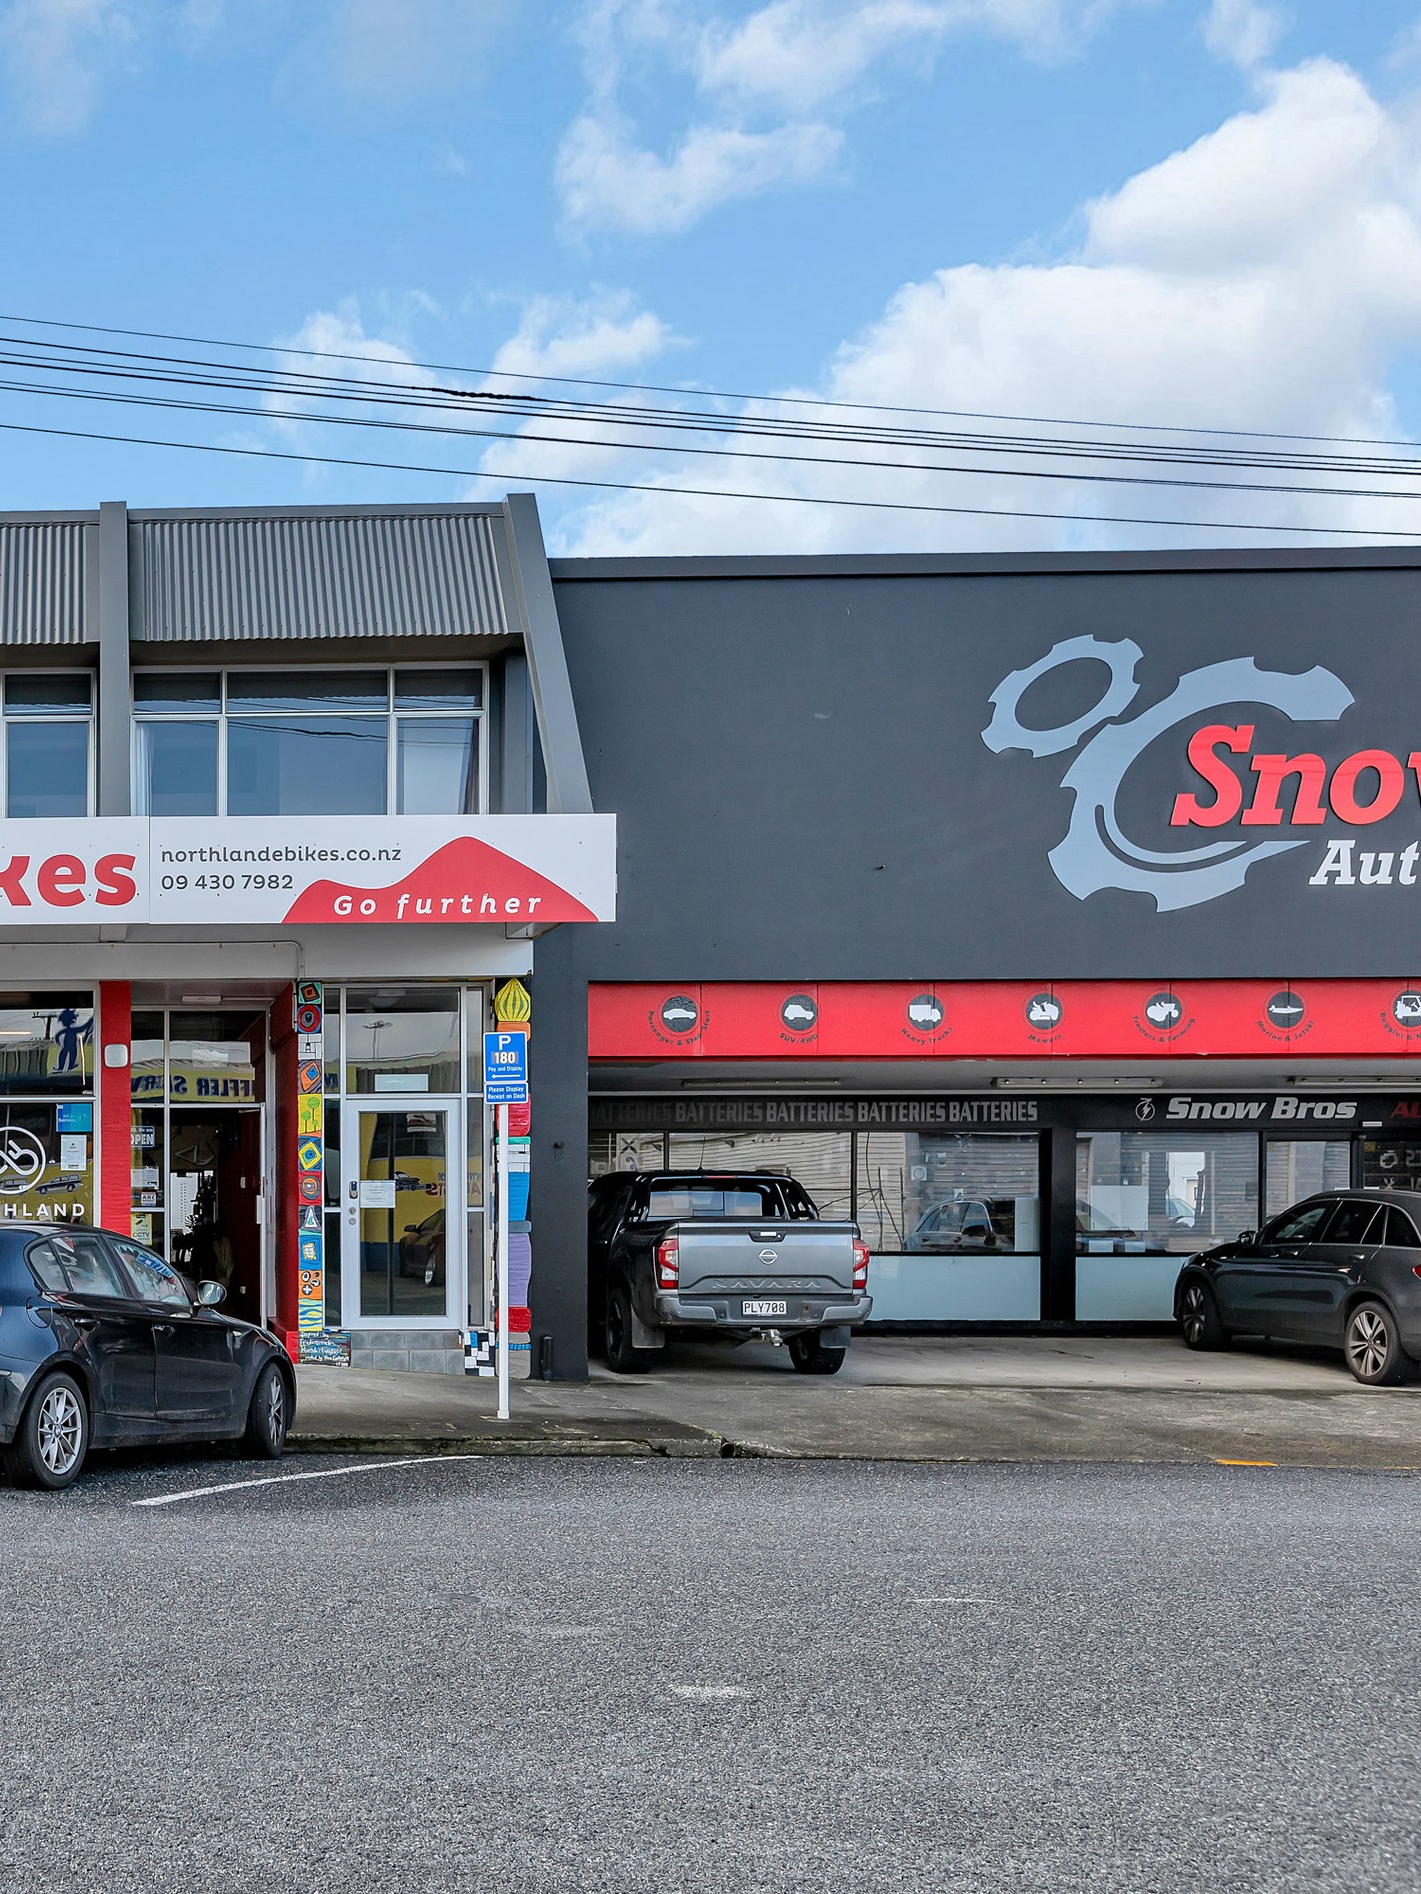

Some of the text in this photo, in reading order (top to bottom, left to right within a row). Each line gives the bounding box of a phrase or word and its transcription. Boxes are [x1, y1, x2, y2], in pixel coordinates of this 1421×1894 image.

[1169, 725, 1421, 828] Sno
[161, 846, 402, 862] northlandebikes.co.nz
[161, 874, 294, 890] 09 430 7982
[334, 893, 542, 920] Go further
[901, 1028, 926, 1046] Heavy
[1256, 1020, 1282, 1042] Marine
[498, 1034, 512, 1050] P
[494, 1052, 516, 1064] 180
[675, 1102, 762, 1122] BATTERIES
[766, 1102, 854, 1122] BATTERIES
[858, 1102, 946, 1122] BATTERIES
[949, 1101, 1038, 1122] BATTERIES
[1166, 1096, 1358, 1120] Snow Bros
[744, 1302, 785, 1313] PLY708
